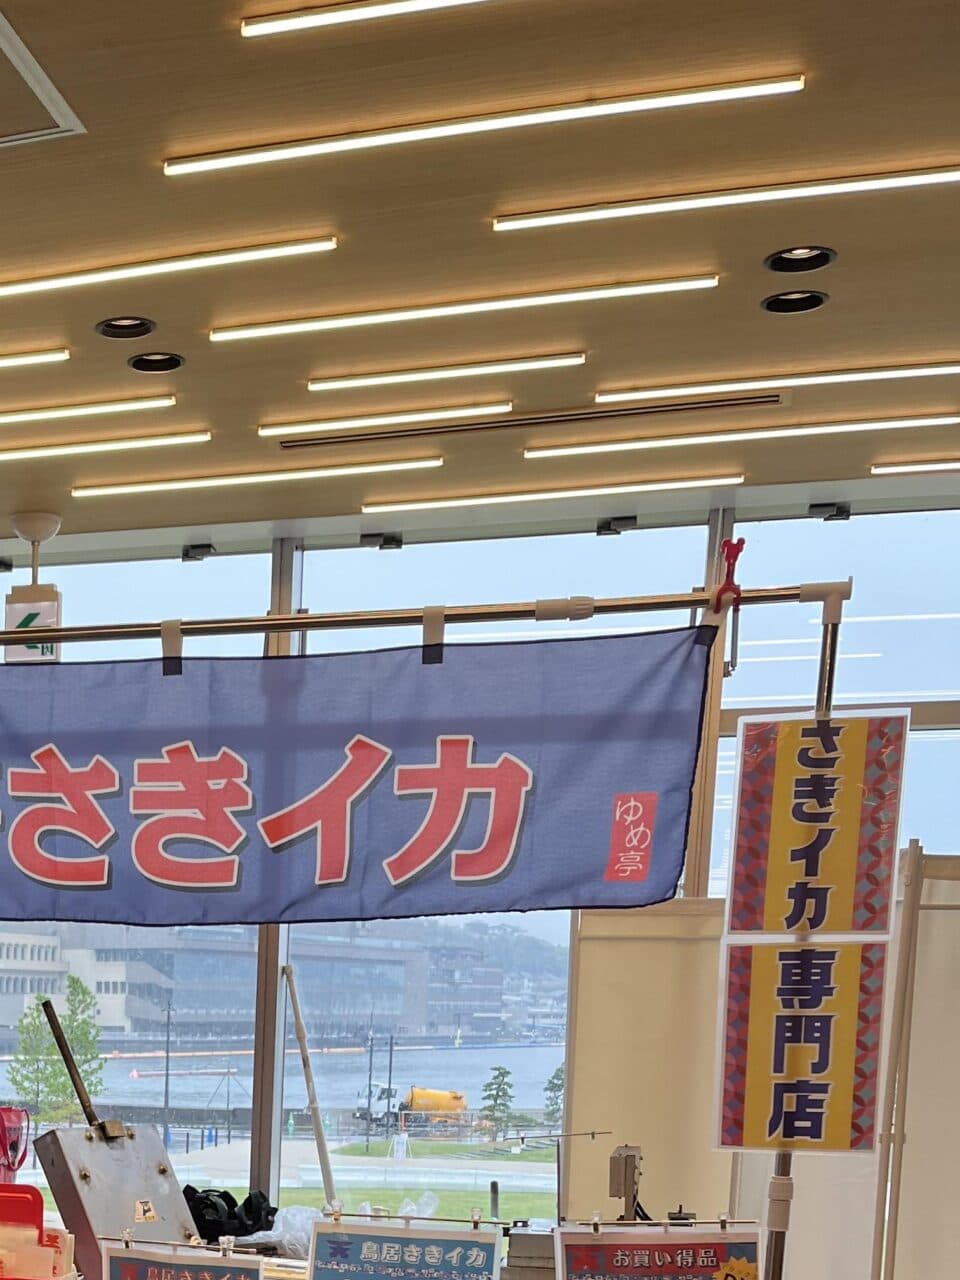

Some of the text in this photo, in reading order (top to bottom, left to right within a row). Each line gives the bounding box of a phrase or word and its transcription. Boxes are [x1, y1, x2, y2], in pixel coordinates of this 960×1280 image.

[614, 796, 652, 878] ゆめ亭
[784, 718, 844, 932] さきイカ
[767, 947, 840, 1142] 専門店
[360, 1240, 487, 1267] 鳥居さきイカ
[612, 1249, 718, 1268] お買い得品
